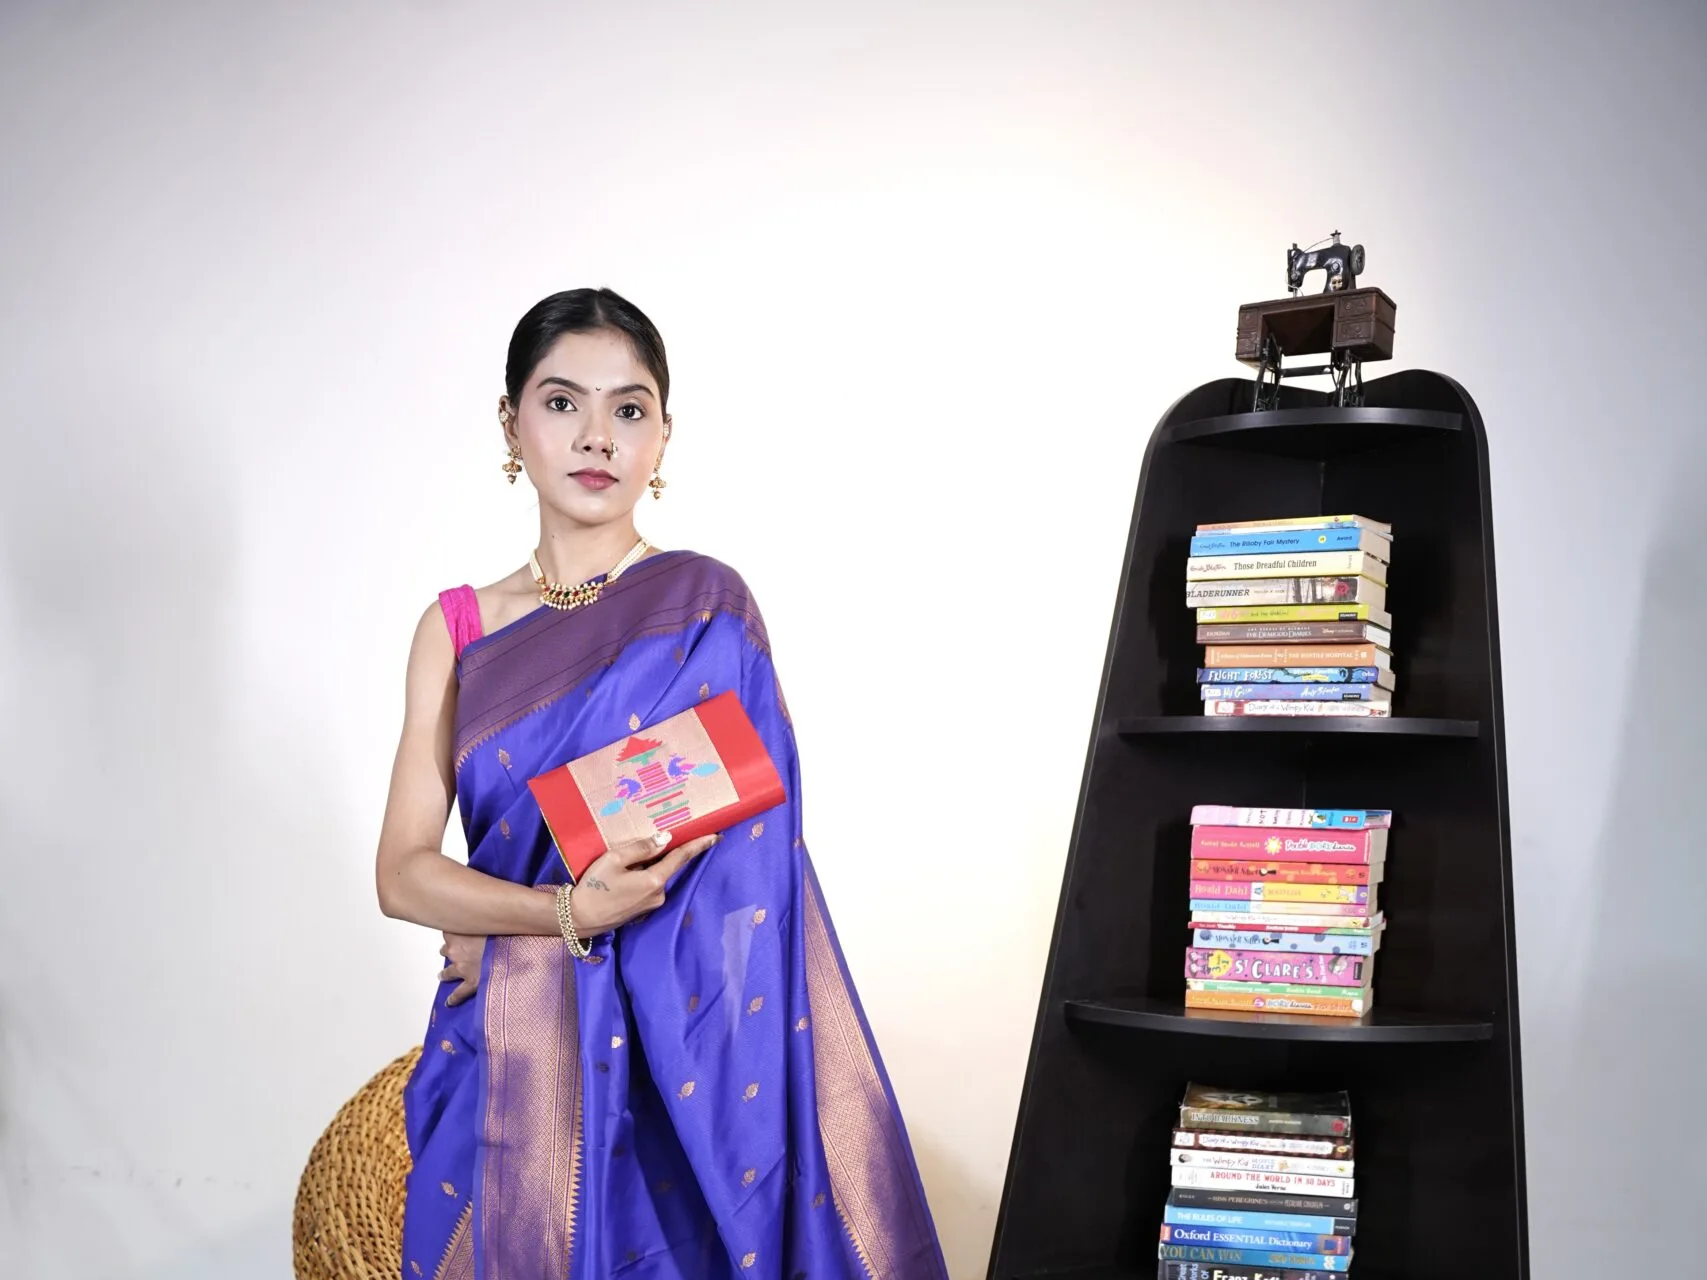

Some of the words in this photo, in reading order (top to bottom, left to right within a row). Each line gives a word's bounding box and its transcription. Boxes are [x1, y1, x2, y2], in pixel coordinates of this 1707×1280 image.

[1256, 560, 1285, 570] Dreadful
[1288, 559, 1317, 568] Children
[1208, 670, 1240, 681] FRIGHT
[1195, 884, 1220, 894] Roald
[1225, 885, 1248, 895] Dahl
[1252, 960, 1313, 978] CLARE'S
[1213, 1157, 1235, 1167] Wimpy
[1237, 1158, 1249, 1166] Kid
[1211, 1172, 1242, 1180] AROUND
[1264, 1175, 1291, 1183] WORLD
[1317, 1178, 1335, 1187] DAYS
[1192, 1213, 1215, 1221] RULES
[1174, 1228, 1210, 1241] Oxford
[1214, 1232, 1266, 1245] ESSENTIAL
[1269, 1237, 1313, 1249] Dictionary
[1160, 1245, 1187, 1258] YOU
[1190, 1247, 1215, 1259] CAN
[1217, 1249, 1240, 1261] WIN
